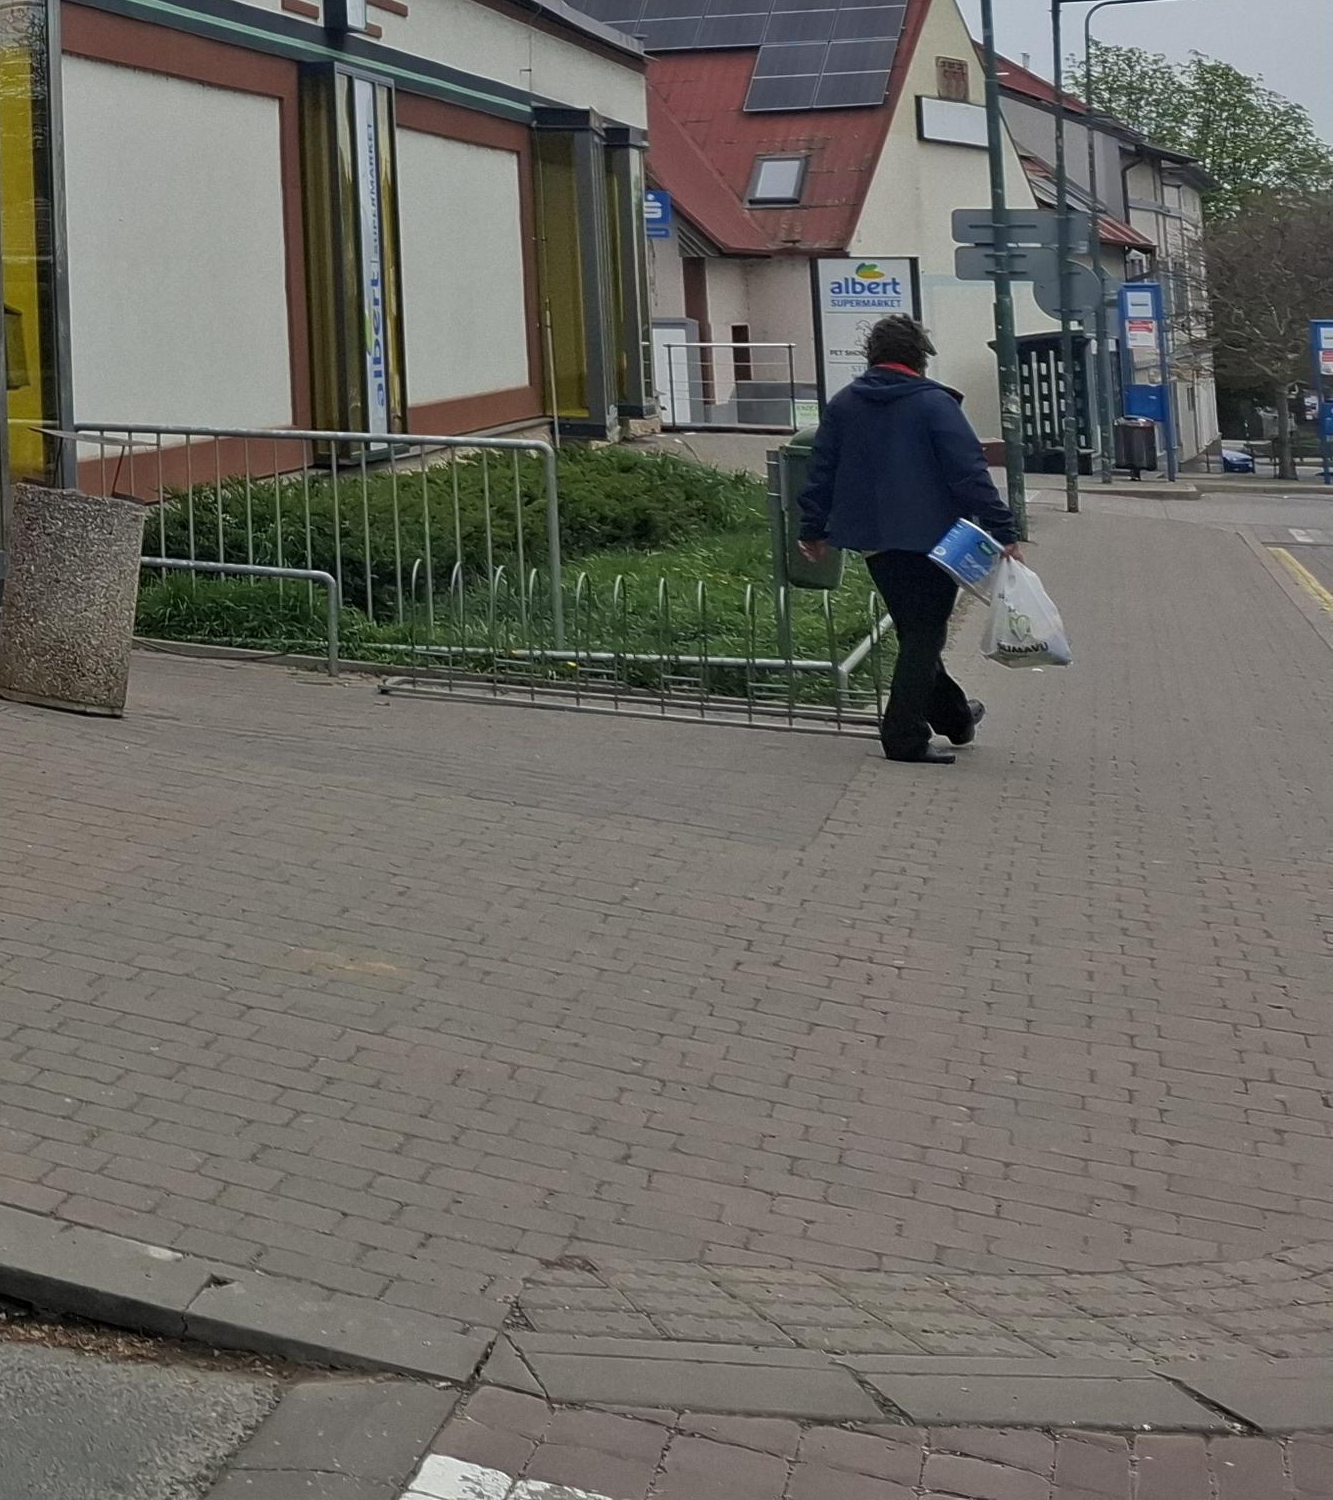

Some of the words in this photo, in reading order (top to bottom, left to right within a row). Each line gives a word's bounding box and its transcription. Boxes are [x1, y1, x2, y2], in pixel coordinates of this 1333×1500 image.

[830, 277, 901, 295] albert
[831, 299, 901, 308] SUPERMARKET
[371, 271, 384, 407] albert
